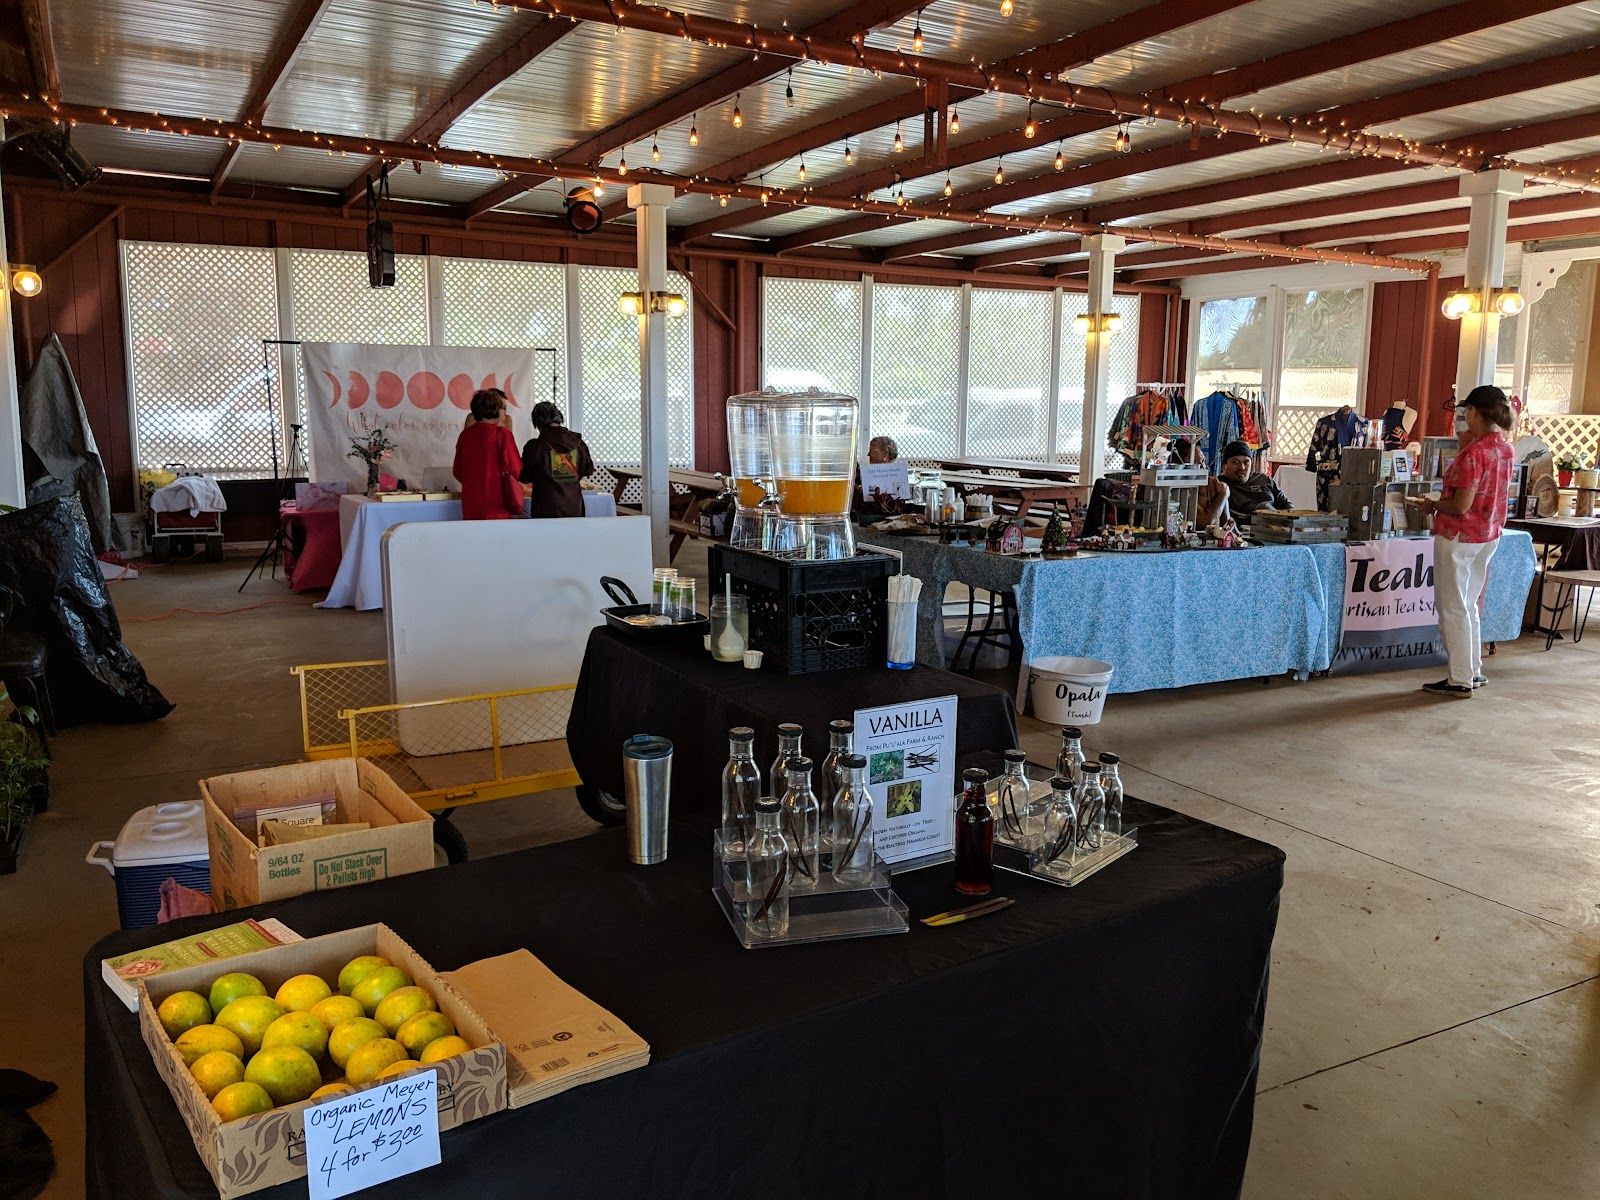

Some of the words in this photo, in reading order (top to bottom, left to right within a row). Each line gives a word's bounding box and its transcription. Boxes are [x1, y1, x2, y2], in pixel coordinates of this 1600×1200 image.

[1345, 601, 1390, 617] rtisan
[1394, 598, 1415, 614] Tea
[1055, 683, 1102, 707] Opala
[869, 708, 943, 734] VANILLA
[1067, 710, 1091, 719] (Trash)
[281, 817, 315, 826] Square
[268, 856, 288, 867] 9/64
[291, 853, 304, 864] OZ
[319, 863, 328, 875] Do
[331, 861, 343, 873] Not
[345, 857, 364, 870] Stack
[366, 855, 382, 866] Over
[269, 867, 301, 879] Bottles
[326, 875, 331, 886] 2
[333, 871, 357, 885] Pallets
[359, 867, 375, 880] High
[310, 1098, 375, 1128] Organic
[382, 1079, 435, 1103] Meyer
[333, 1097, 427, 1144] LEMONS
[320, 1150, 337, 1188] 4
[341, 1145, 371, 1171] for
